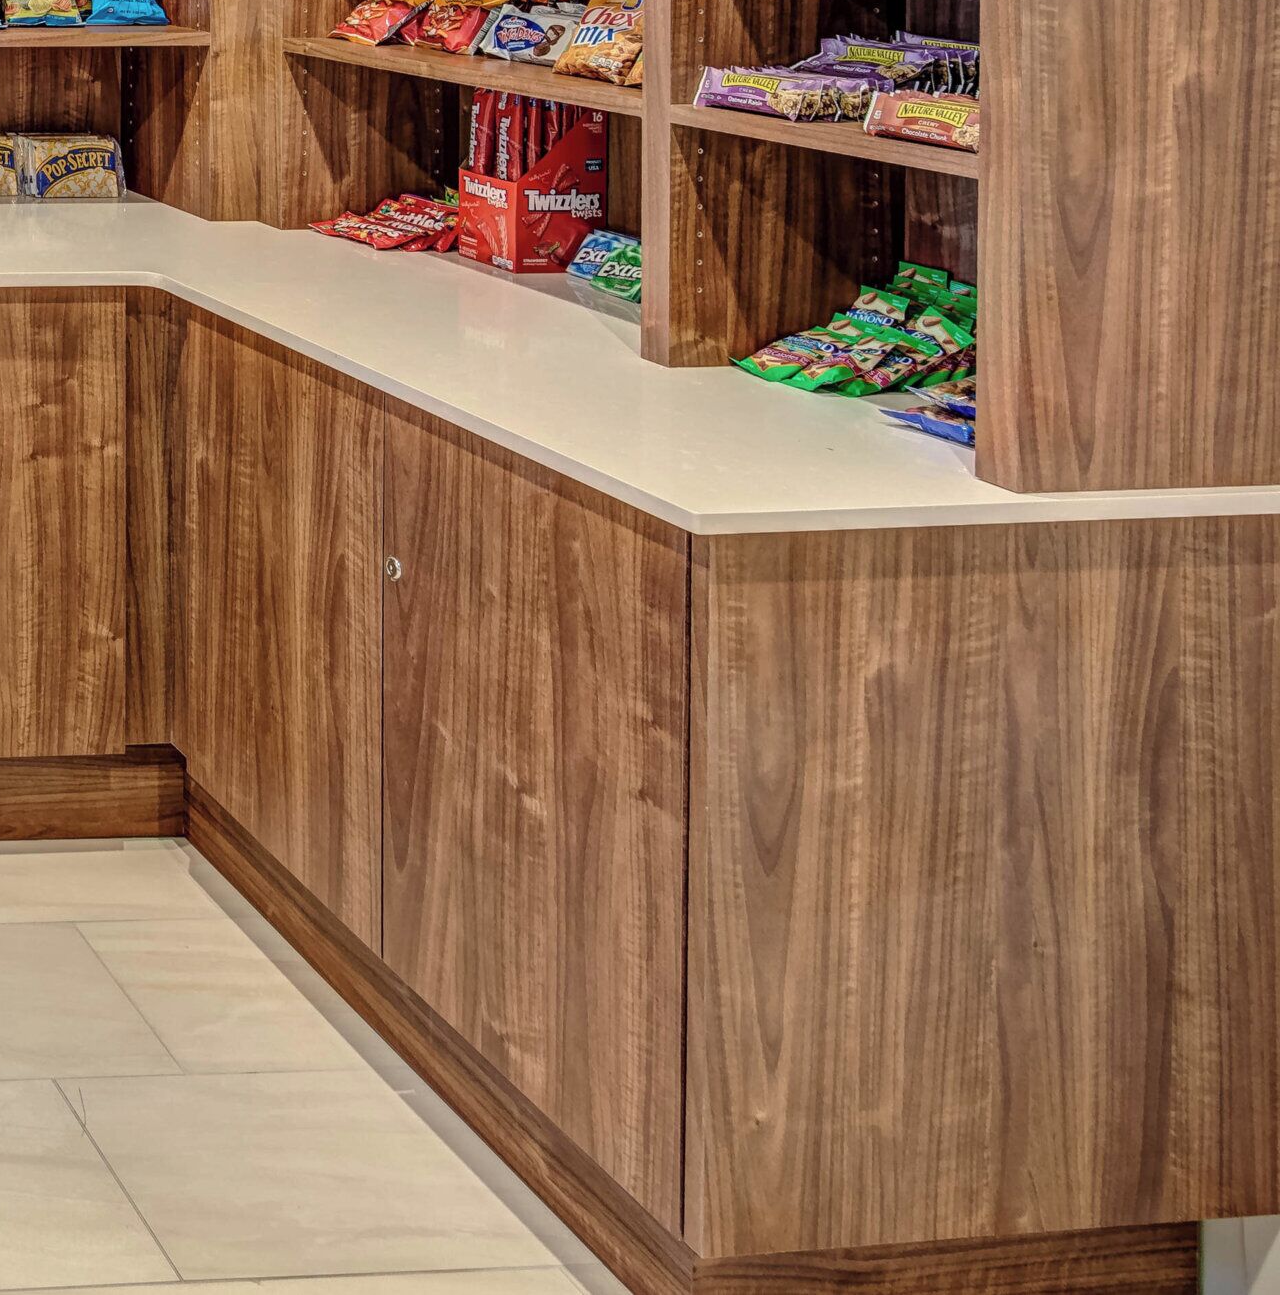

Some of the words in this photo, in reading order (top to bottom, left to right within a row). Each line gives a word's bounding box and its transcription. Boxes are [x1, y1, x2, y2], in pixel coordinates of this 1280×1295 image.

[581, 6, 642, 27] Chex
[850, 46, 876, 58] NATURE
[875, 49, 903, 62] VALLEY
[833, 64, 854, 72] Oatmeal
[724, 73, 753, 84] NATURE
[752, 76, 776, 91] VALLEY
[727, 96, 747, 105] Oatmeal
[747, 98, 763, 106] Raisin
[592, 112, 603, 123] 16
[901, 103, 935, 117] NATURE
[935, 106, 967, 124] VALLEY
[917, 120, 939, 128] CHEWY
[901, 127, 929, 138] Chocolate
[929, 131, 947, 141] Chunk
[45, 162, 69, 183] POP
[69, 152, 112, 172] SECRET
[463, 176, 507, 201] Twizzlers
[487, 199, 508, 210] twists
[524, 188, 600, 211] Twizzlers
[571, 208, 602, 220] twists
